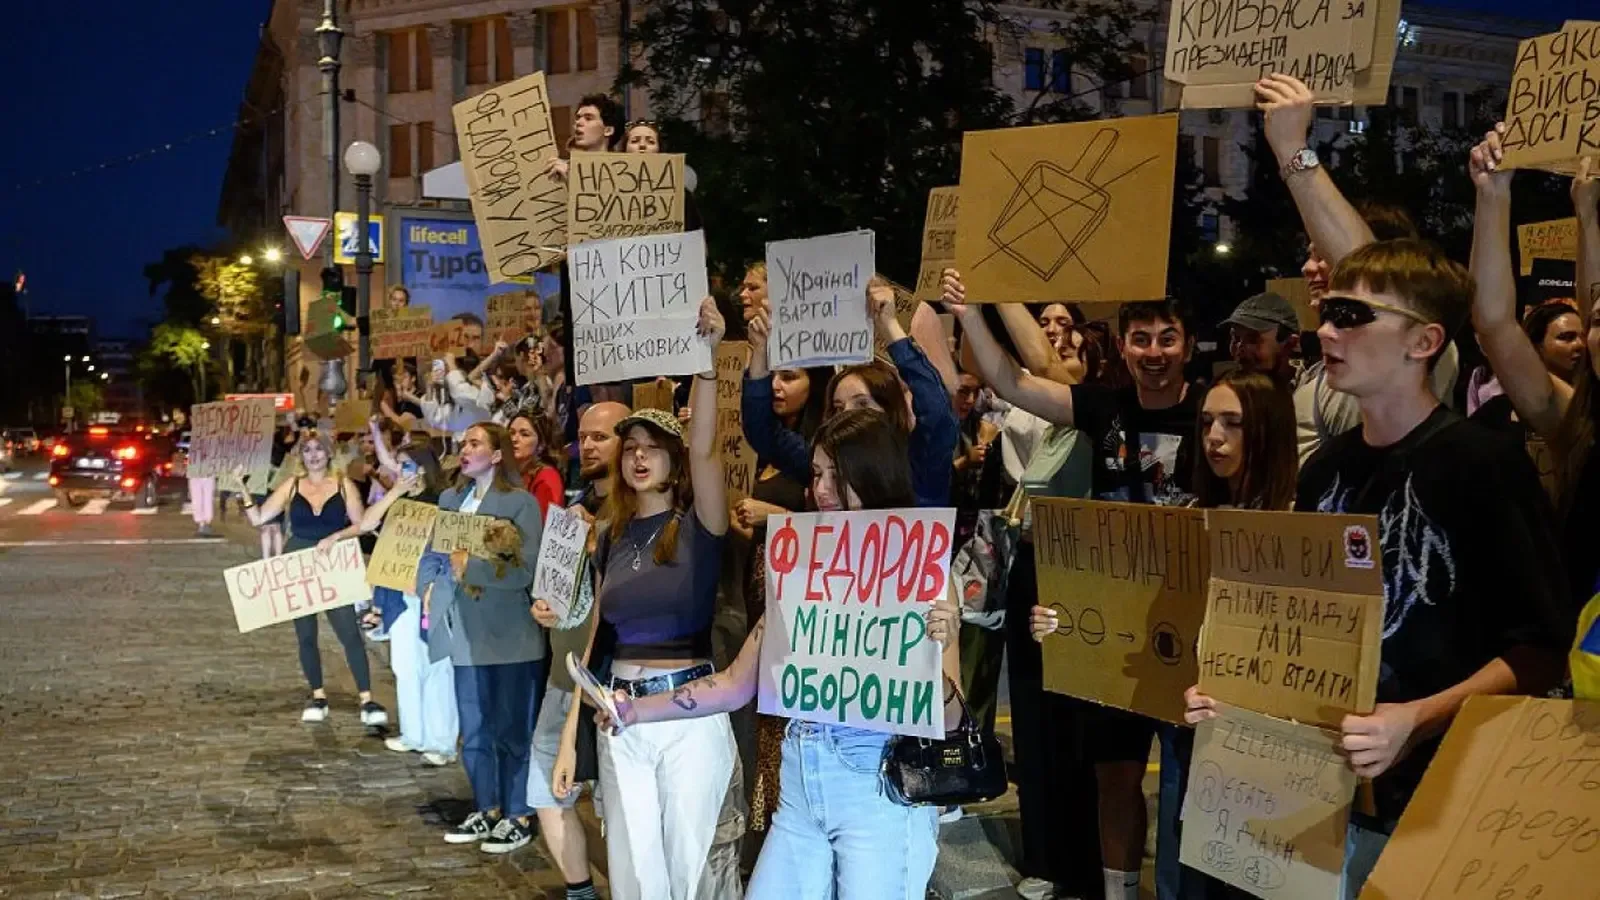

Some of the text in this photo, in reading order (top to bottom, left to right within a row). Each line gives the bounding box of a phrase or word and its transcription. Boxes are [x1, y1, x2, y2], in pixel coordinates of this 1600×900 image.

[1177, 0, 1365, 42] КРИВБАСА ЗА
[1171, 36, 1288, 73] ПРЕЗИДЕНТА
[1514, 39, 1539, 74] А
[1512, 67, 1600, 116] ВІЙСЬ
[508, 84, 555, 163] ГЕТЬ
[1501, 109, 1569, 152] ДОСІ
[1576, 122, 1600, 155] К
[467, 92, 521, 207] ФЕДОРОВА
[577, 159, 676, 193] НАЗАД
[486, 198, 527, 221] У
[575, 193, 675, 223] БУЛАВУ
[410, 225, 468, 245] lifecell
[493, 230, 543, 278] МО
[409, 249, 487, 280] Турб
[575, 241, 683, 282] НА КОНУ
[777, 256, 860, 301] Україна!
[575, 271, 689, 325] ЖИТТЯ
[575, 321, 636, 347] НАШИХ
[576, 335, 692, 376] ВІЙСЬКОВИХ
[1035, 503, 1085, 572] ПАНЕ
[1219, 530, 1335, 581] ПОКИ ВИ
[236, 541, 360, 600] СИРСЬКИЙ
[769, 515, 950, 608] ФЕДОРОВ
[267, 578, 338, 618] ГЕТЬ
[1215, 587, 1361, 634] ДІЛИТЕ ВЛАДУ
[1257, 622, 1302, 657] МИ
[780, 663, 934, 727] ОБОРОНИ
[1202, 651, 1353, 703] НЕСЕМО ВТРАТИ
[1215, 808, 1230, 841] Я
